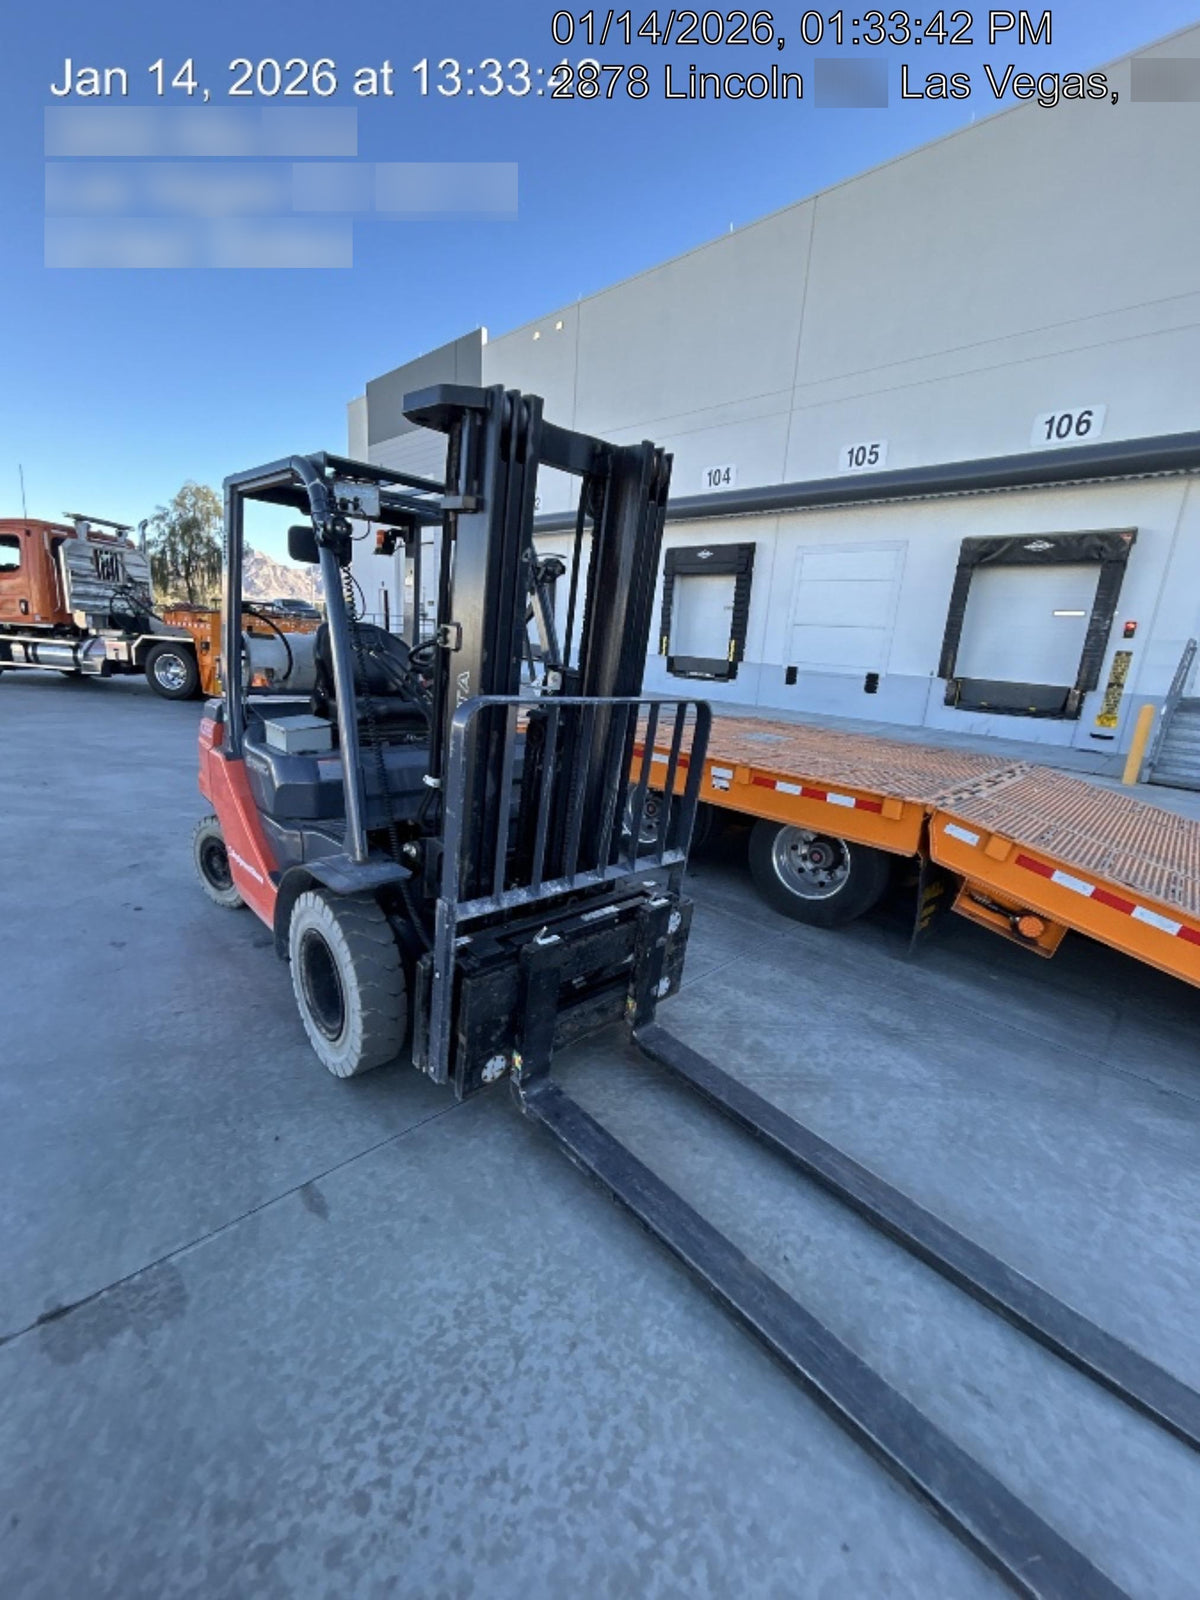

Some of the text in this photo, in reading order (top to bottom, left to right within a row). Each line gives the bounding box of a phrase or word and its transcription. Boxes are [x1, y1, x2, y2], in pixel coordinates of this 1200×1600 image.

[1045, 410, 1093, 440] 106
[847, 444, 880, 468] 105
[707, 467, 731, 487] 104
